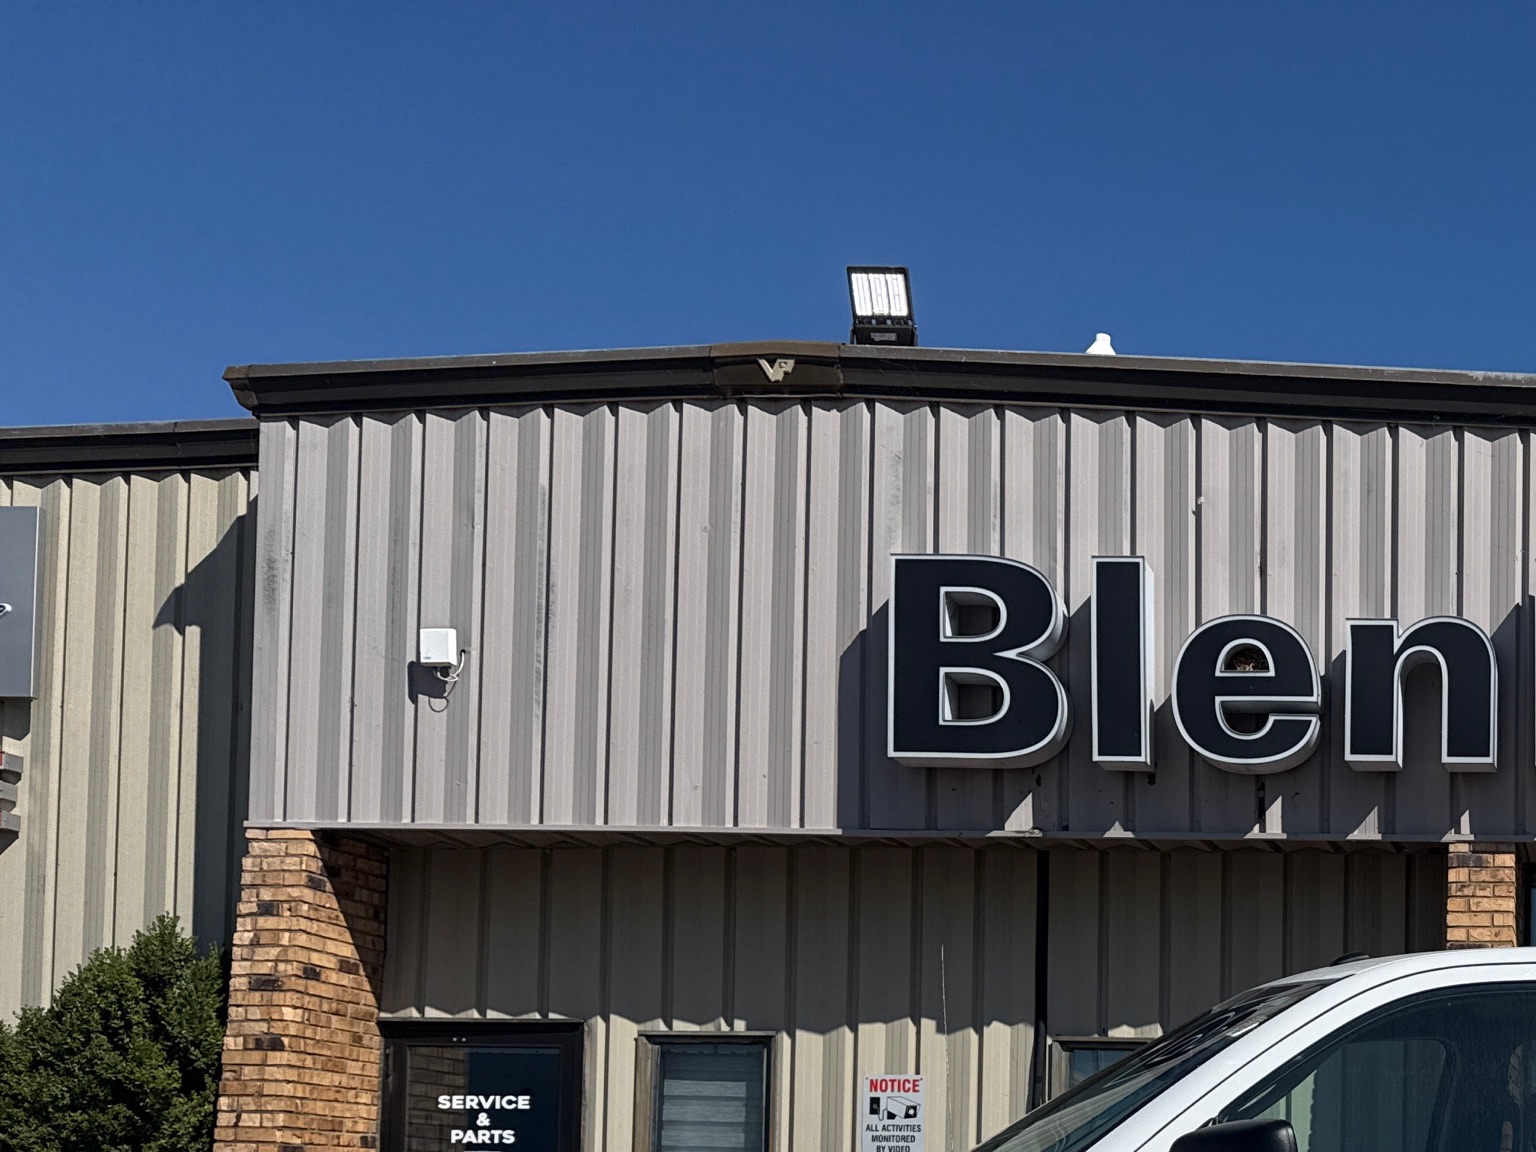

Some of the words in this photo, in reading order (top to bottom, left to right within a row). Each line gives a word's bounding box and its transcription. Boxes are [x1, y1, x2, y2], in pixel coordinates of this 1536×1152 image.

[869, 1078, 920, 1093] NOTICE
[437, 1095, 531, 1110] SERVICE
[476, 1112, 491, 1126] &
[865, 1124, 879, 1132] ALL
[881, 1124, 921, 1132] ACTIVITIES
[450, 1129, 515, 1144] PARTS
[871, 1134, 916, 1143] MONITORED
[876, 1145, 886, 1152] BY
